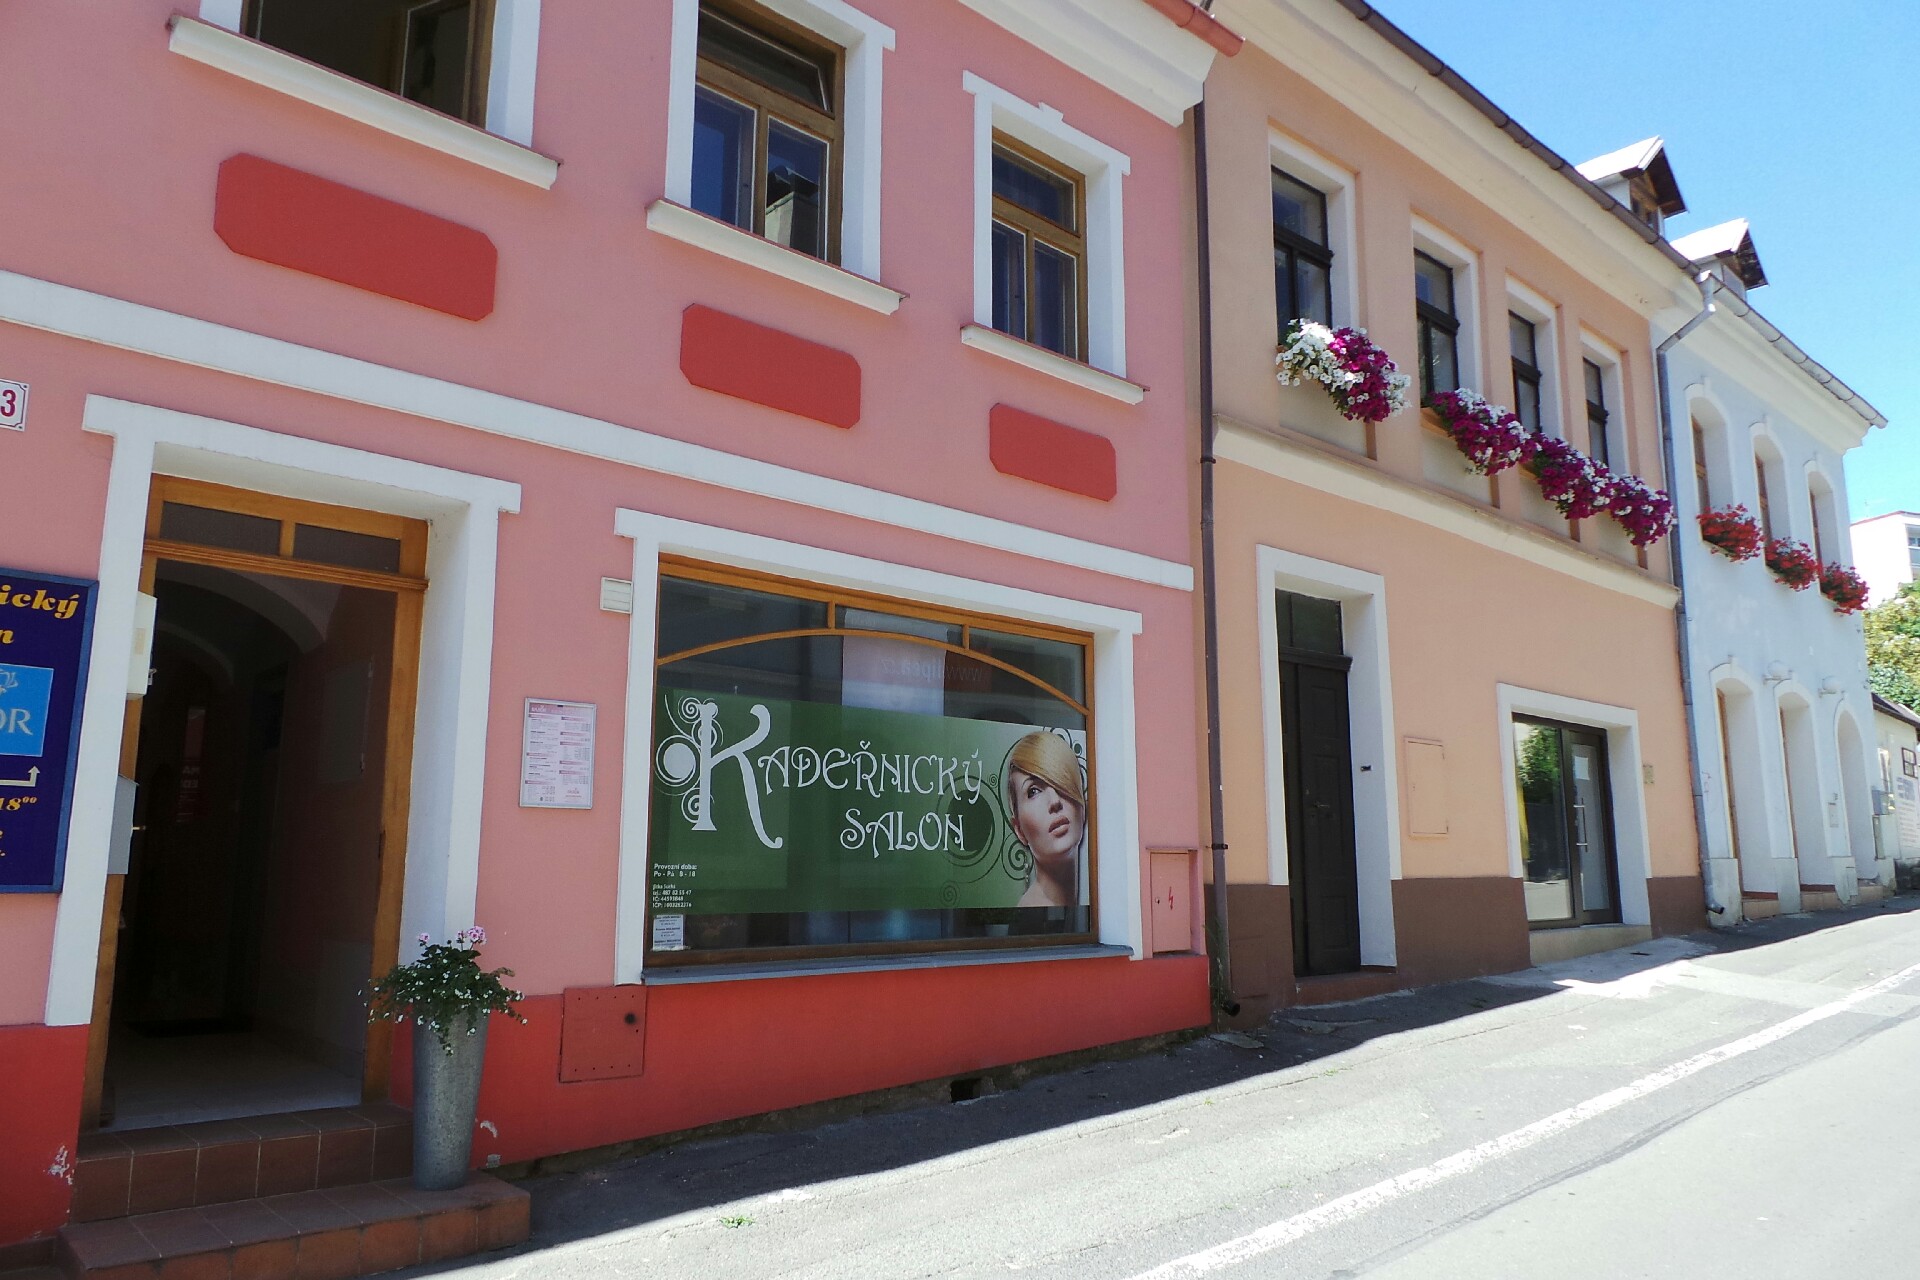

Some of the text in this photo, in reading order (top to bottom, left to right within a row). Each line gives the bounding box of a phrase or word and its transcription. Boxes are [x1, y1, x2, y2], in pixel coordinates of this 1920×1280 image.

[1, 389, 16, 417] 3
[0, 708, 33, 736] R
[840, 808, 966, 858] SALON
